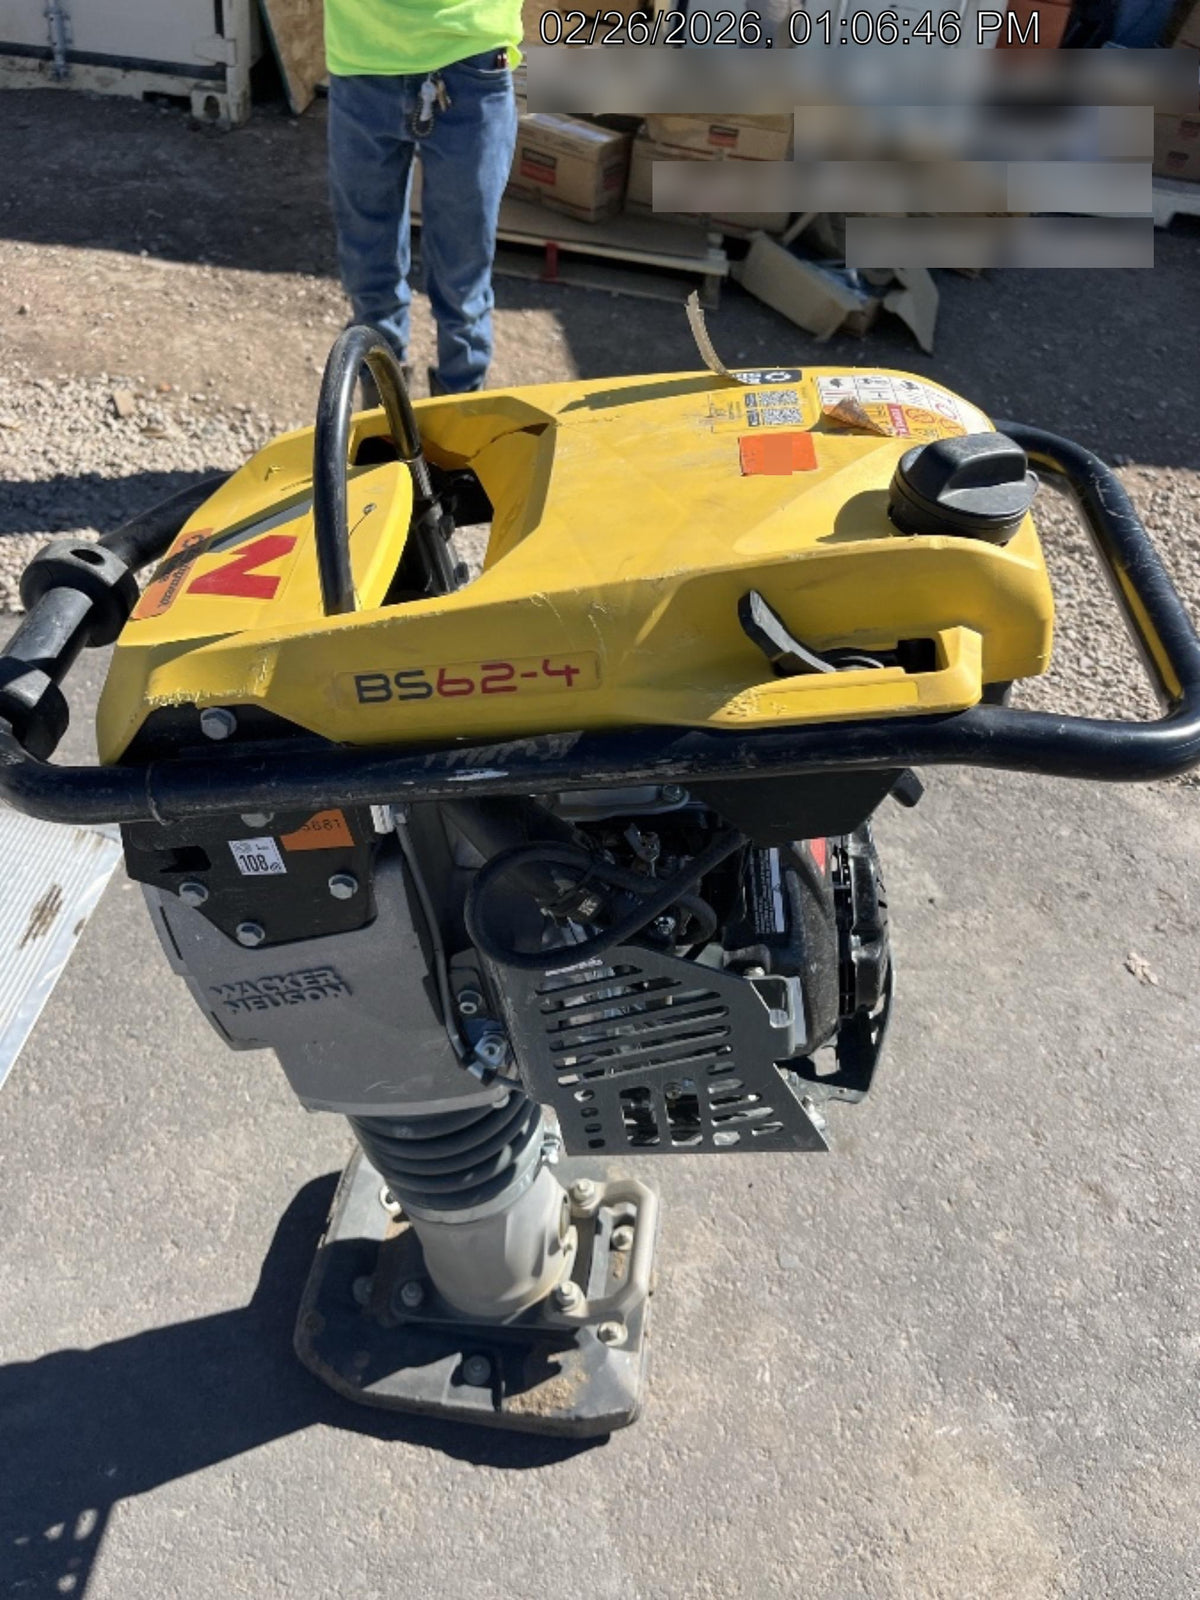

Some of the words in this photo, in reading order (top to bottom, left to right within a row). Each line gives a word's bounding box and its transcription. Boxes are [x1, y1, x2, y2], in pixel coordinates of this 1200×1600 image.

[354, 658, 580, 704] BS62-4
[239, 854, 269, 873] 108
[209, 966, 341, 998] WACKER
[223, 980, 354, 1015] NEUSON
